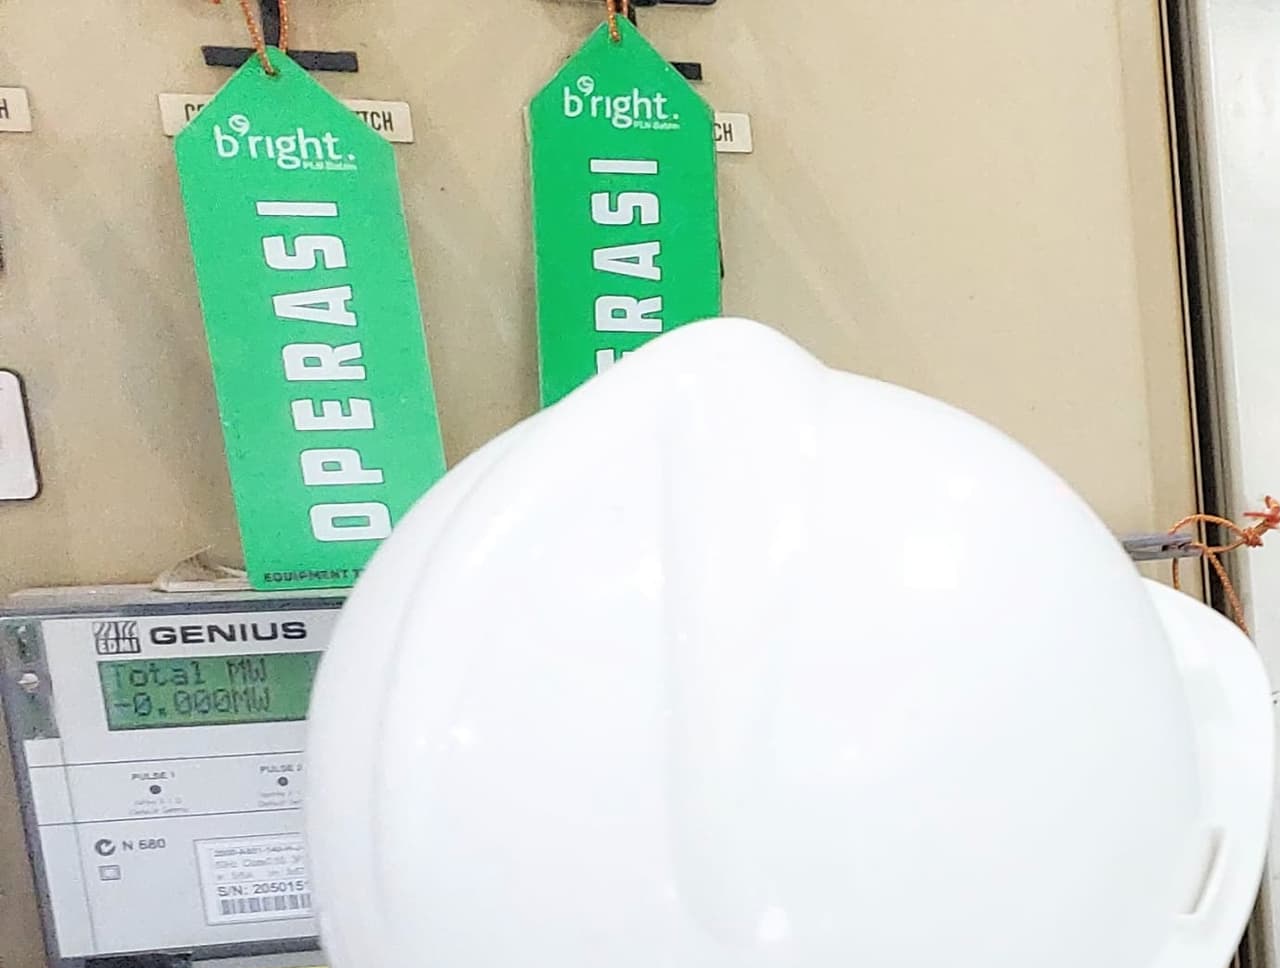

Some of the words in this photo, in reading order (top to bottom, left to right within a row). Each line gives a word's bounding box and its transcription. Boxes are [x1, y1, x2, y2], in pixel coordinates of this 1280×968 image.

[589, 158, 664, 334] RASI
[254, 199, 393, 544] OPERASI
[149, 621, 308, 645] GENIUS
[110, 661, 202, 690] Total
[226, 659, 267, 684] MW
[122, 840, 136, 851] N
